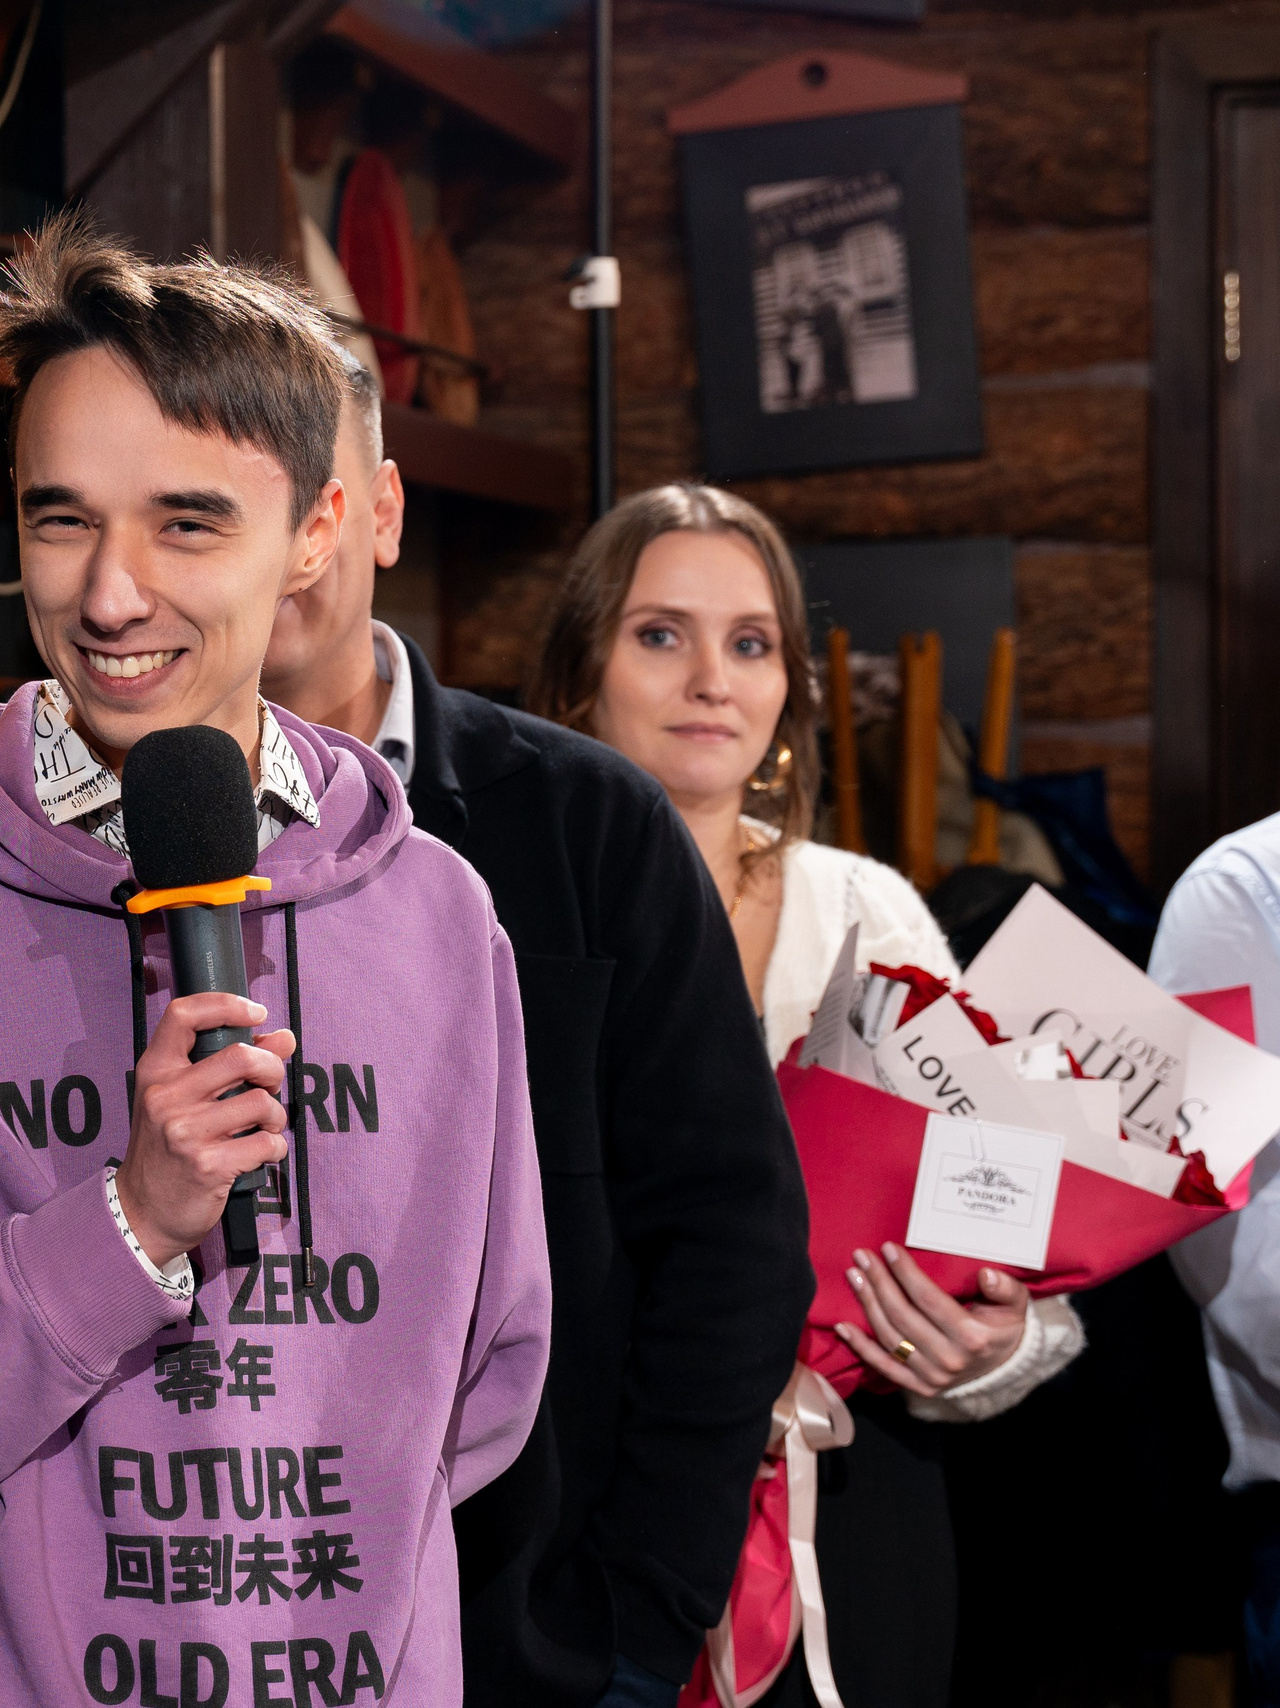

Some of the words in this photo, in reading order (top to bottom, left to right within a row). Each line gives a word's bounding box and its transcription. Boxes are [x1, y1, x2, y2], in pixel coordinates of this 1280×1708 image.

[206, 951, 217, 982] WIRELESS
[902, 1035, 976, 1116] LOVE
[1110, 1024, 1180, 1079] LOVE
[228, 1252, 380, 1325] ZERO
[153, 1337, 277, 1415] 零年
[97, 1444, 352, 1522] FUTURE
[103, 1528, 365, 1606] 回到未来
[83, 1632, 231, 1708] OLD
[250, 1629, 387, 1708] ERA
